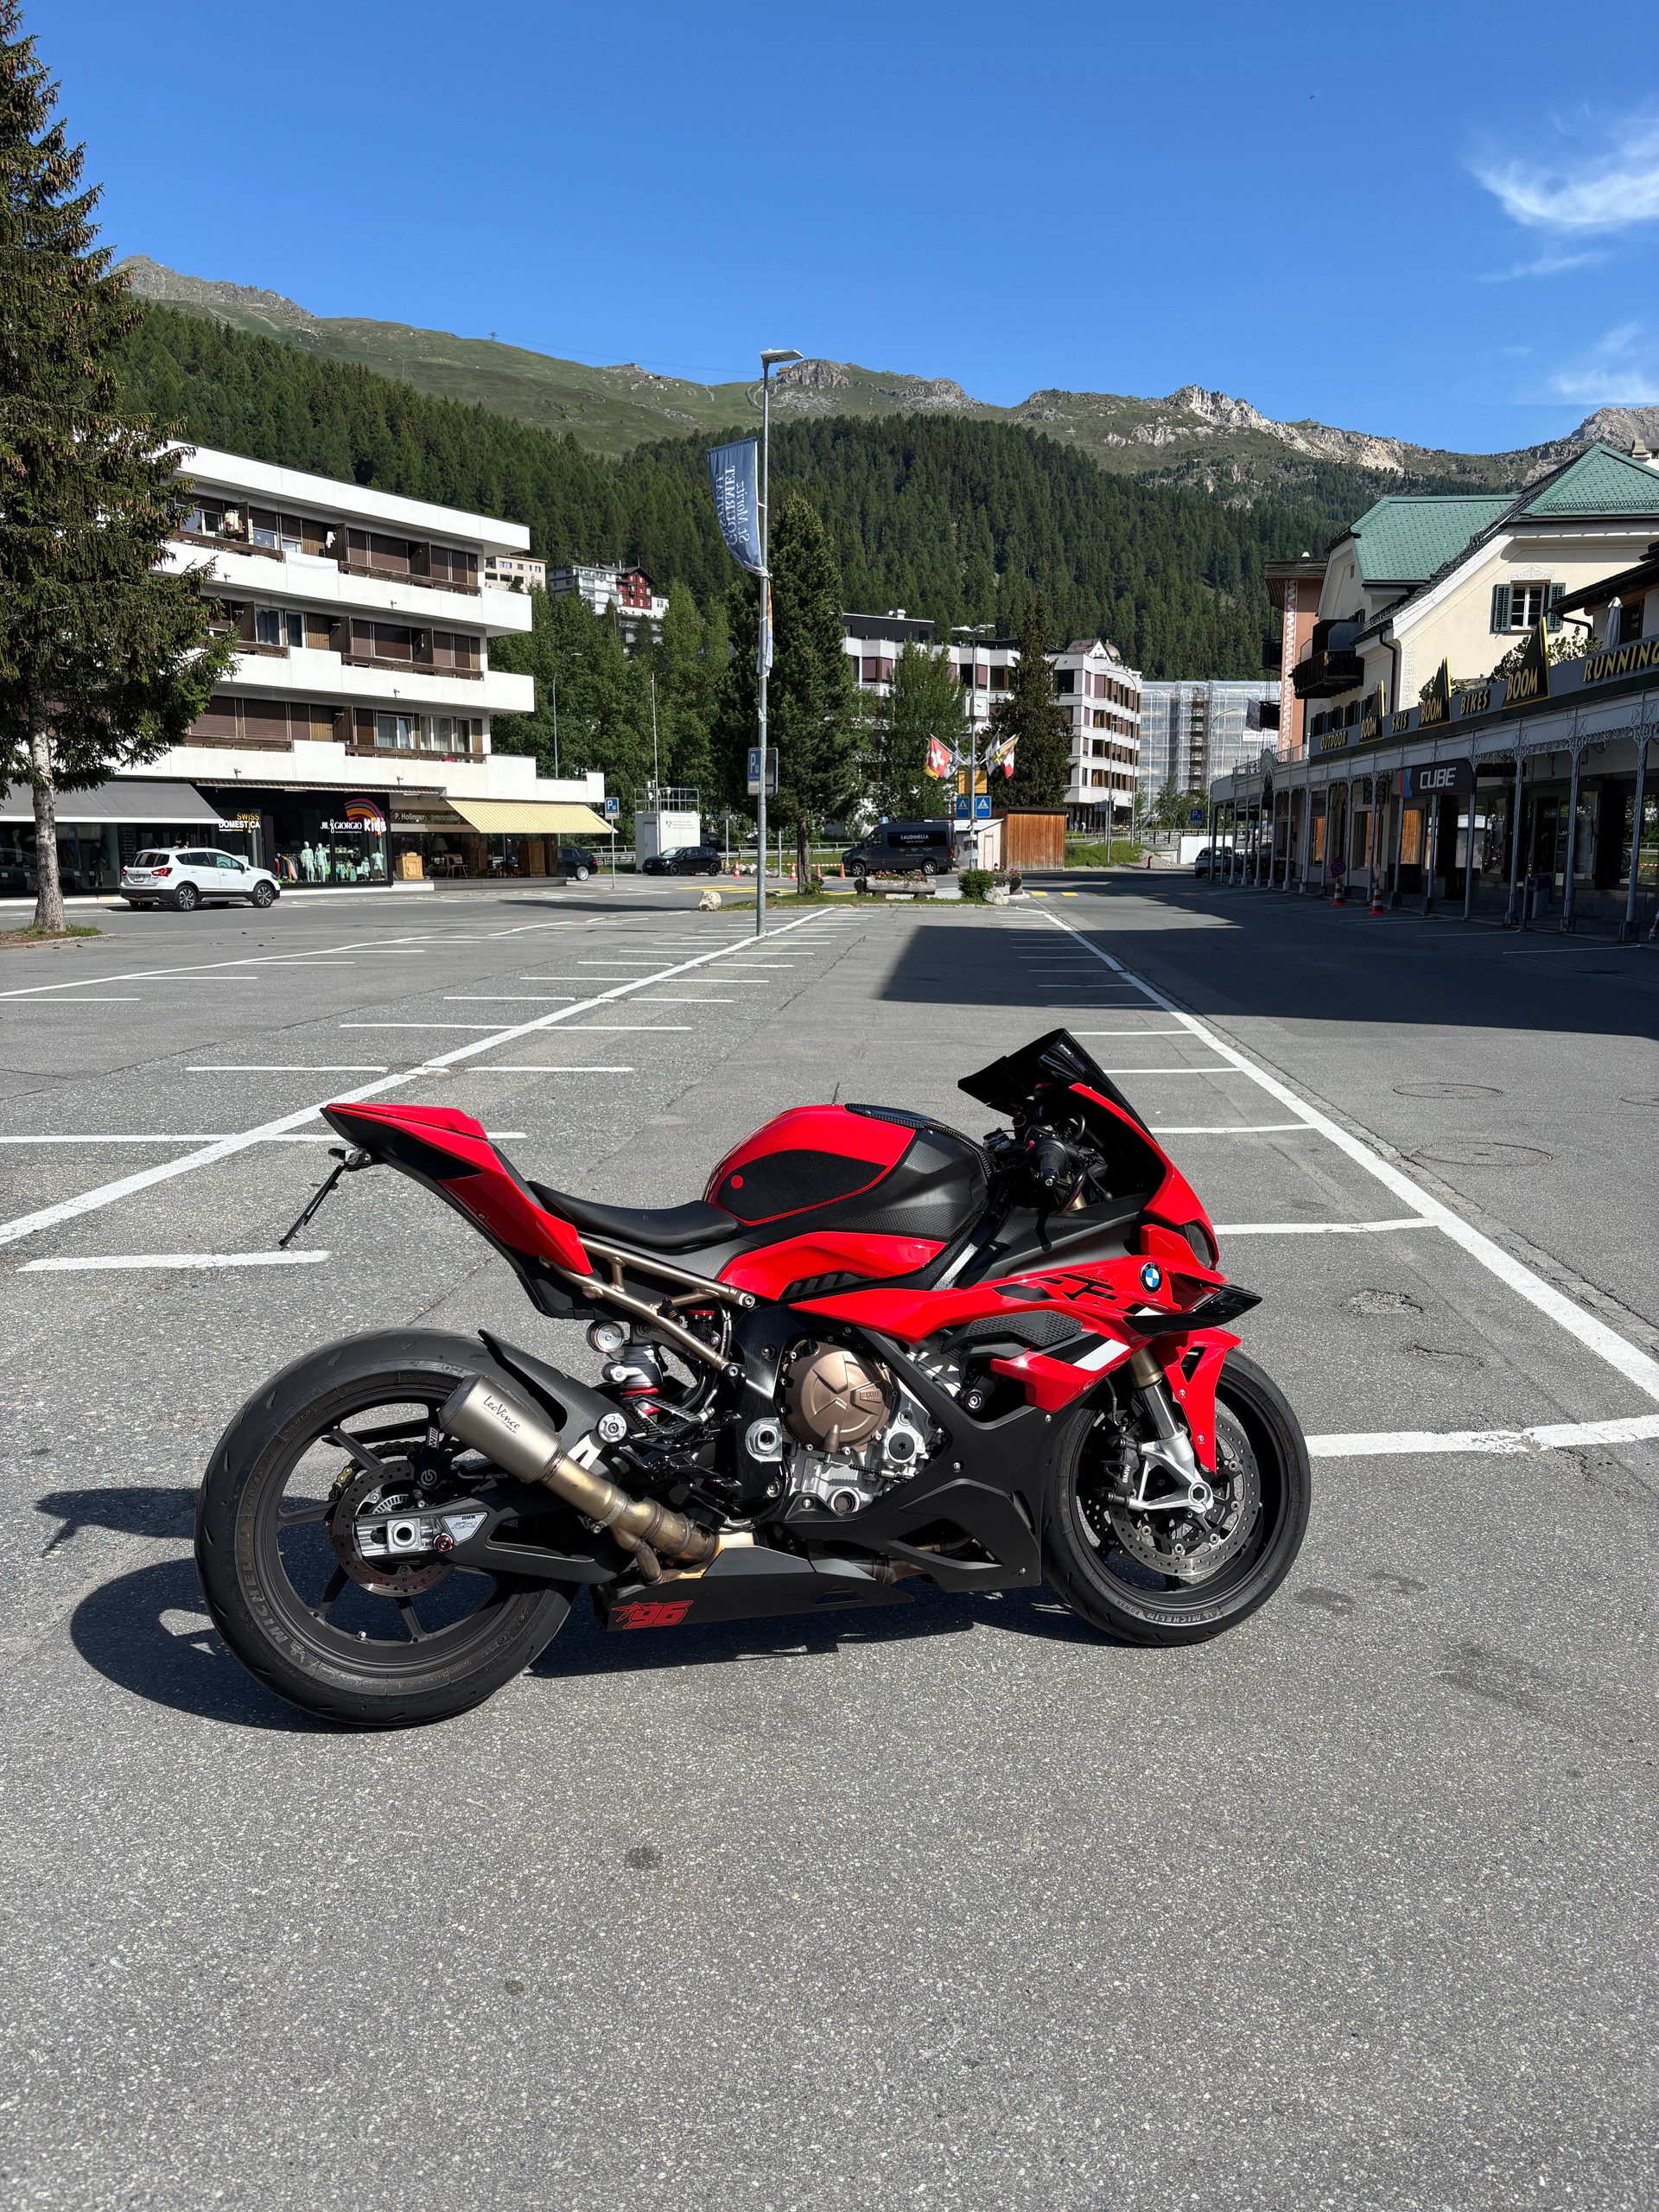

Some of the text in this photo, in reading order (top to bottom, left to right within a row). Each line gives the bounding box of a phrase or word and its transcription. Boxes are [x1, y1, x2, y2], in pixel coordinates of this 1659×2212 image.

[1319, 639, 1659, 751] OUTDOOR BOOM SKIS BOOM BIKES BOOM RUNNING
[1420, 767, 1457, 790] CUBE
[237, 812, 260, 821] SWISS
[364, 817, 388, 833] Kids
[483, 1395, 520, 1430] LeoVince
[1122, 1464, 1131, 1484] BMW
[1116, 1599, 1202, 1624] MICHELIN POWER
